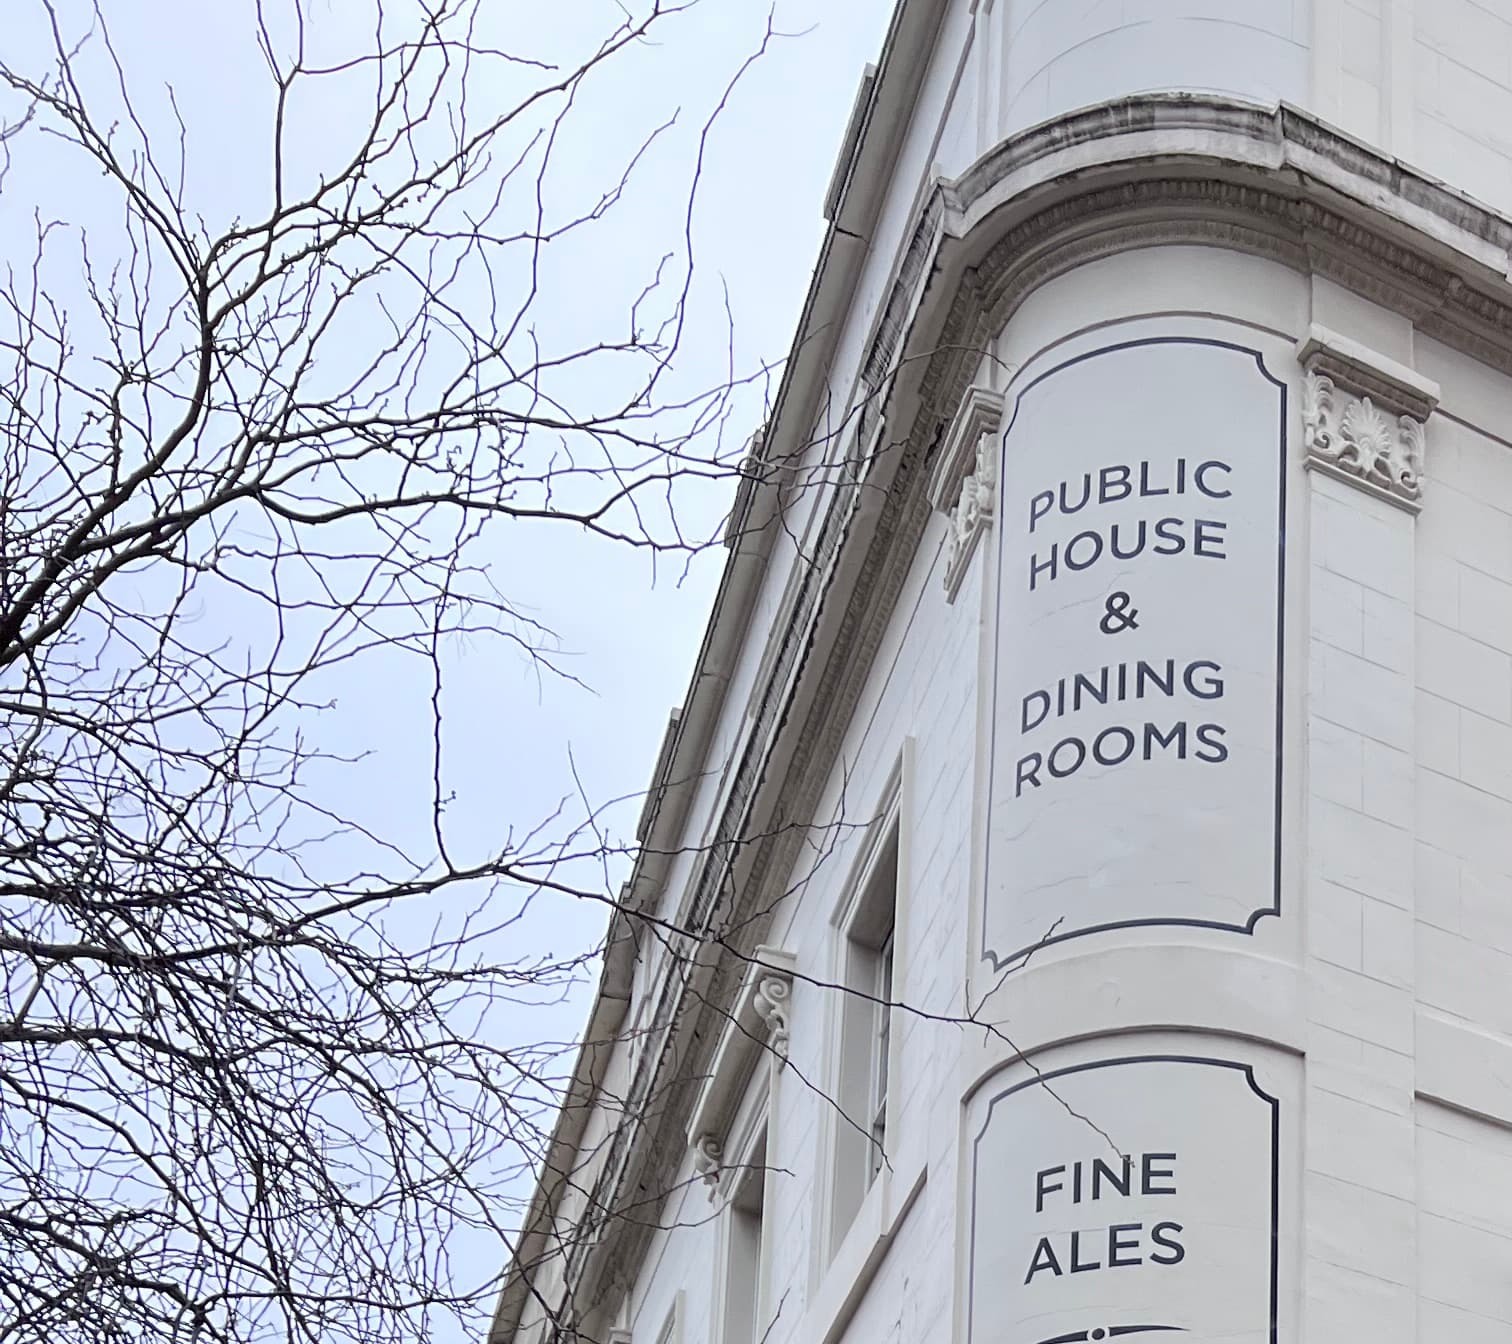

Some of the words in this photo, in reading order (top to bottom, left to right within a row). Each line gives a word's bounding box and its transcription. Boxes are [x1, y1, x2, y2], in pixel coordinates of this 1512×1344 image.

[1029, 458, 1233, 534] PUBLIC
[1029, 517, 1227, 592] HOUSE
[1099, 591, 1140, 635] &
[1021, 659, 1224, 735] DINING
[1015, 721, 1229, 798] ROOMS
[1035, 1152, 1177, 1213] FINE
[1023, 1221, 1186, 1286] ALES
